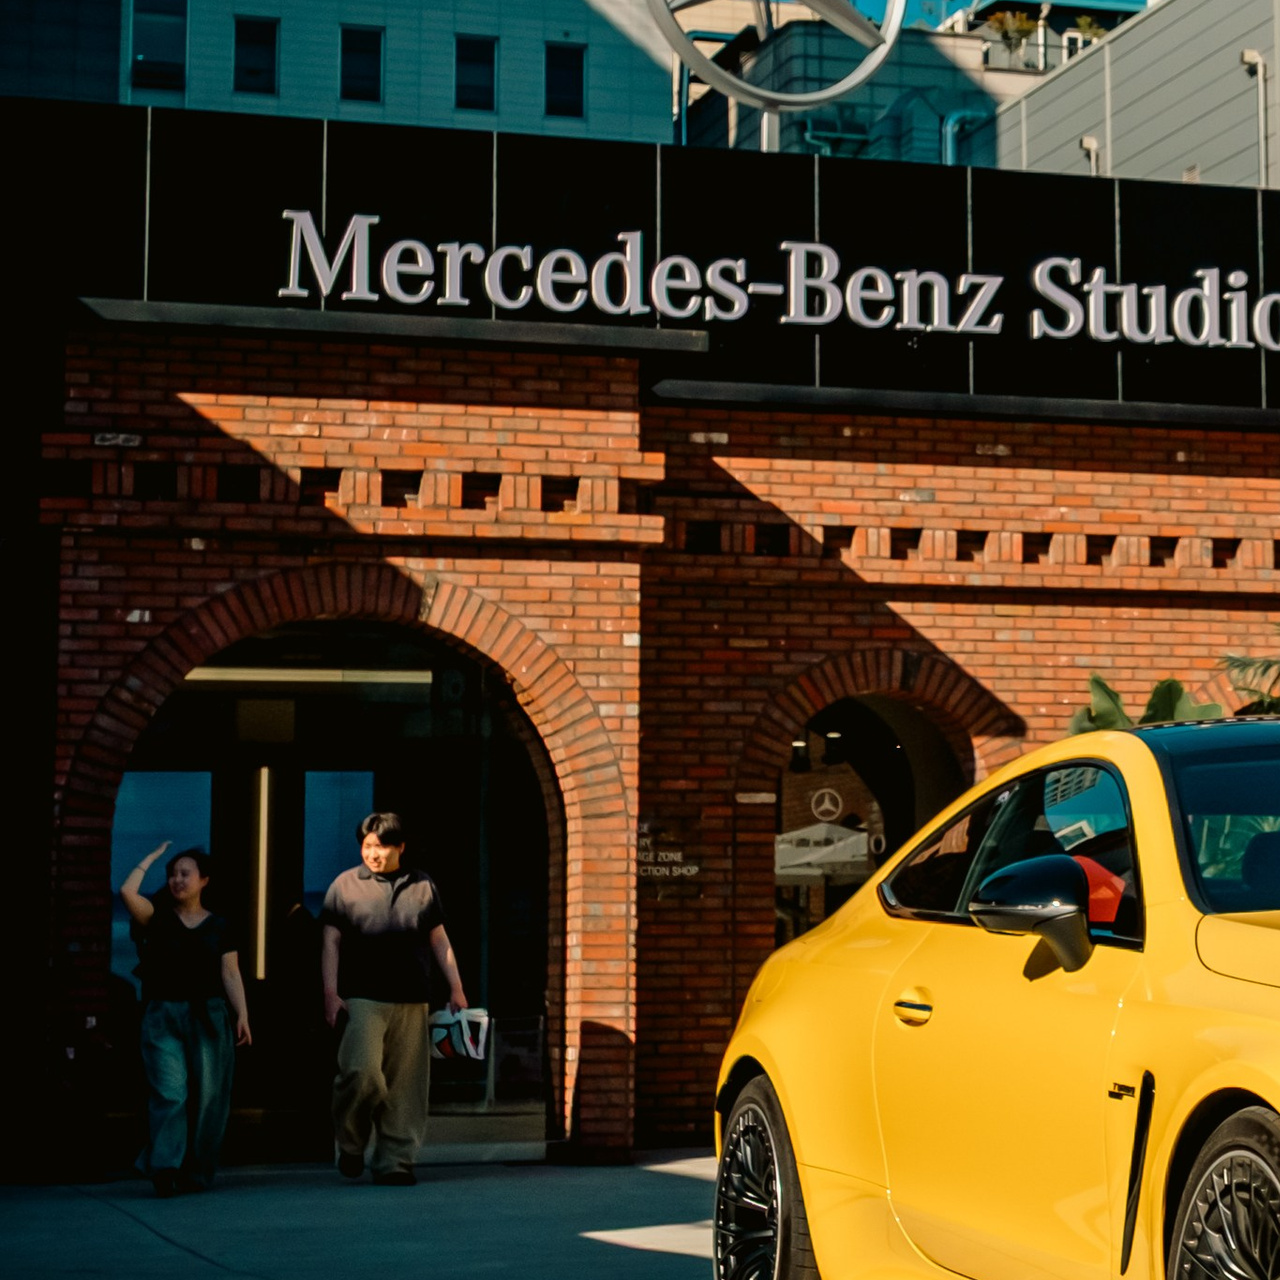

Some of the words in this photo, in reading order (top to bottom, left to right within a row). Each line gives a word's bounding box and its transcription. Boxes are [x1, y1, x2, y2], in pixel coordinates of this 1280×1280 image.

[278, 208, 1004, 335] Mercedes-Benz
[639, 865, 670, 877] CTION
[671, 865, 700, 877] SHOP
